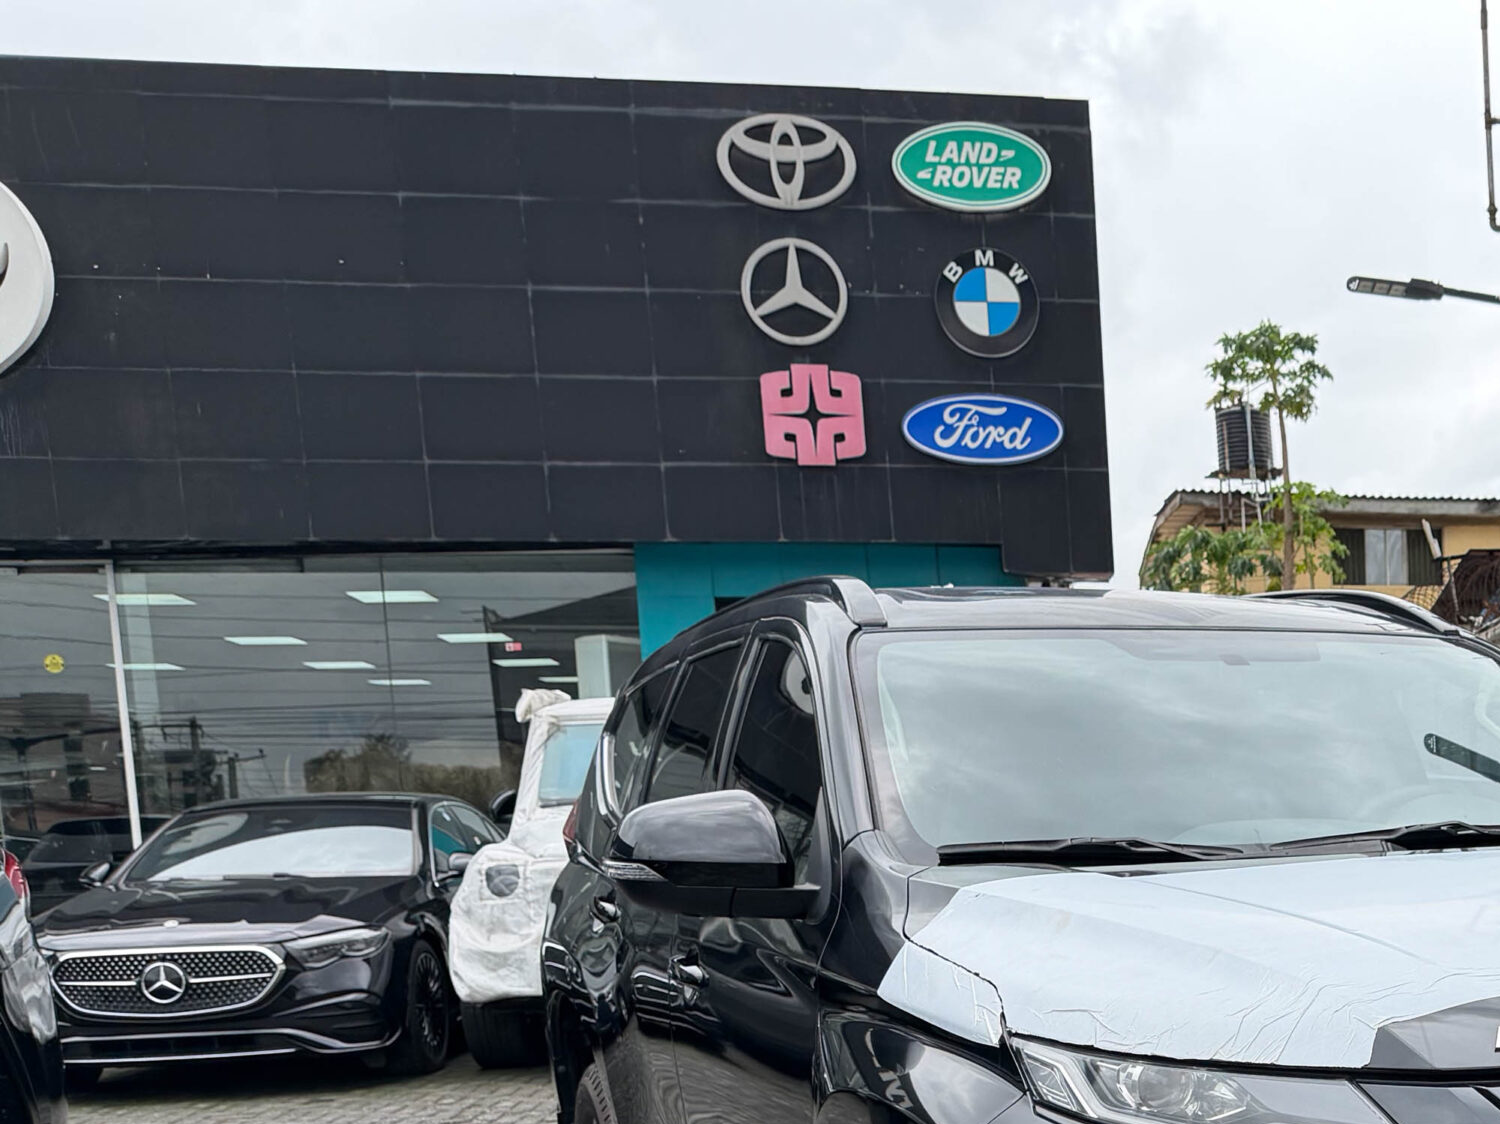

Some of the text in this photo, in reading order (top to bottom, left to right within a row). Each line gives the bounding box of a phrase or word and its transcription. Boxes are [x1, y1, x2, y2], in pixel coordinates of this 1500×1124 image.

[925, 140, 1001, 165] LAND
[932, 165, 1022, 190] ROVER
[943, 249, 1029, 283] BMW
[934, 403, 1032, 451] Ford
